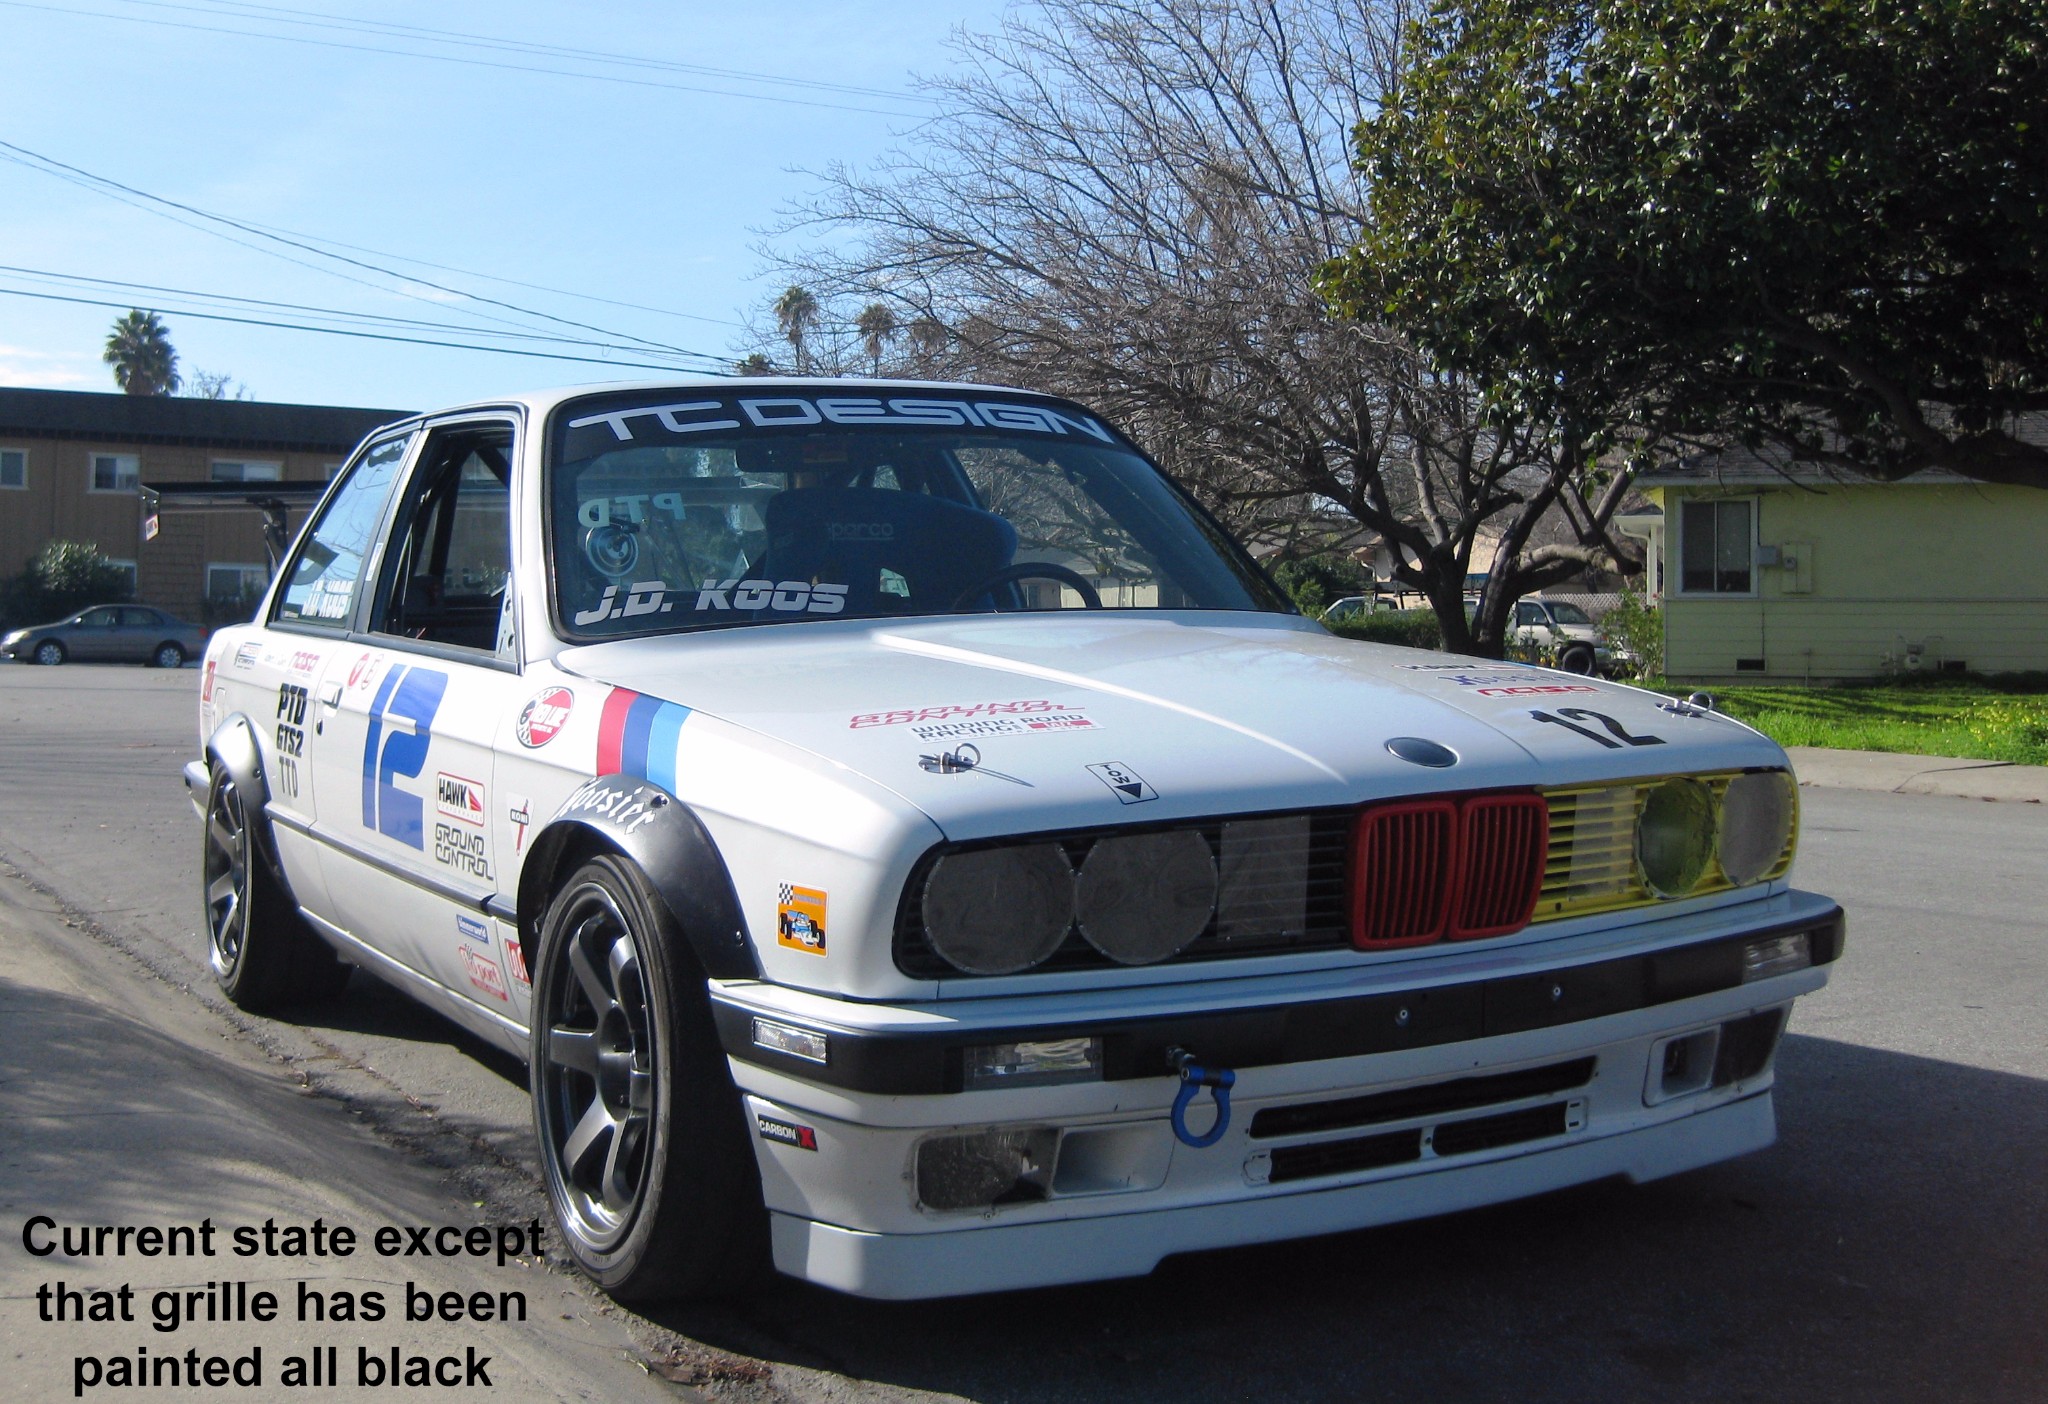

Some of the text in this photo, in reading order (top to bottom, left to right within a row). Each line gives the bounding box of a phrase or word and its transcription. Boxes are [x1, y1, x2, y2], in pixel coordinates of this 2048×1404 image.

[827, 522, 894, 541] parco
[575, 579, 850, 627] J.D. KOOS
[276, 682, 309, 726] PTD
[1477, 685, 1600, 696] nasa
[849, 705, 1085, 729] CONTROL
[850, 700, 1050, 723] GROUND
[911, 719, 1015, 733] WINDING
[1020, 714, 1084, 724] ROAD
[276, 723, 304, 759] GTS2
[919, 724, 1013, 739] RACING
[1528, 707, 1668, 749] 12
[363, 663, 449, 852] 12
[278, 755, 299, 799] TTD
[1100, 764, 1131, 784] TOW
[438, 778, 468, 809] HAWK
[548, 776, 656, 835] Hoosier
[435, 823, 485, 857] GROUND
[435, 843, 494, 881] CONTROL
[759, 1118, 797, 1140] CARBON
